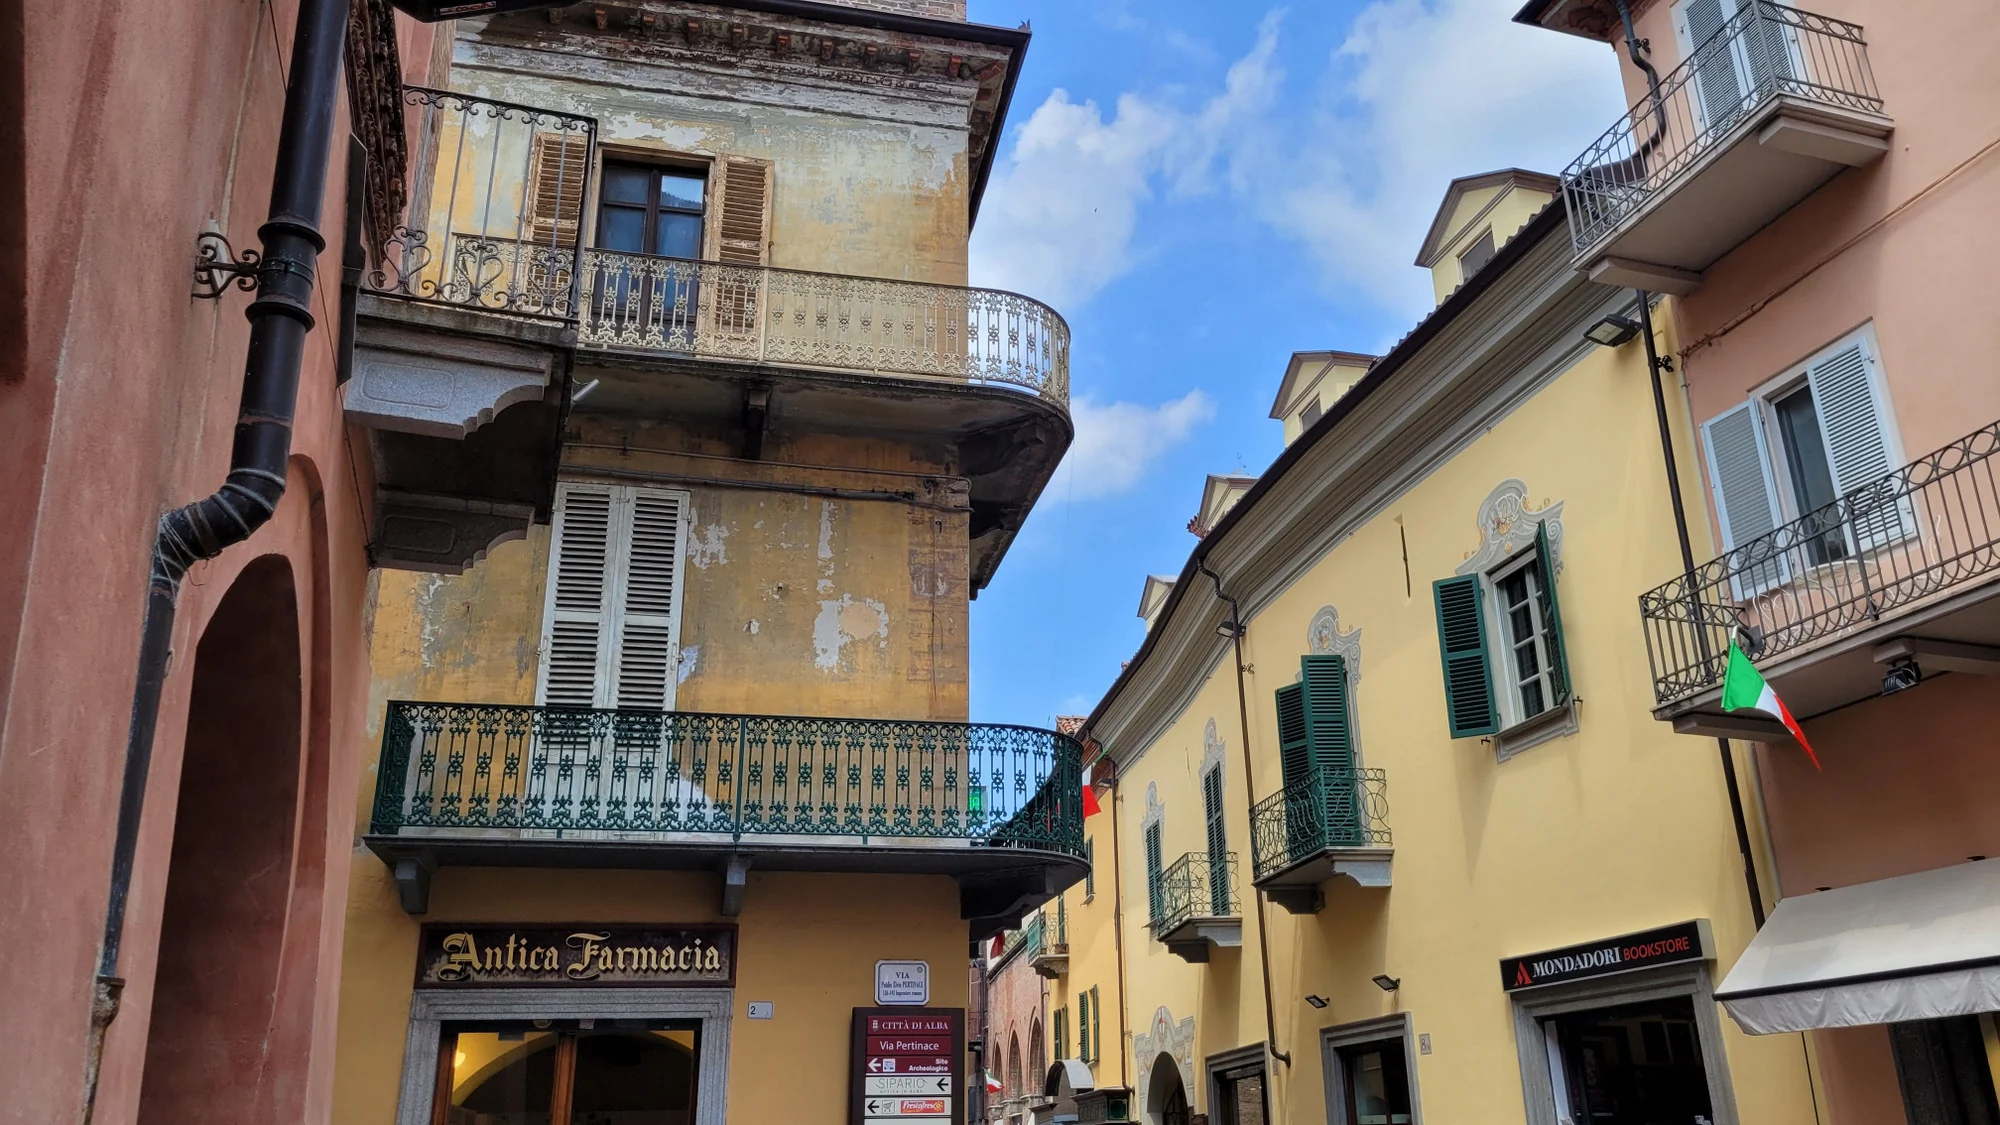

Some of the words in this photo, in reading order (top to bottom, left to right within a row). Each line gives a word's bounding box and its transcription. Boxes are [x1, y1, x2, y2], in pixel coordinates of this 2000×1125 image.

[438, 932, 559, 980] Antica
[565, 931, 721, 979] Farmacia
[1532, 946, 1622, 978] MONDADORI
[1623, 936, 1690, 961] BOOKSTORE
[895, 971, 910, 979] VIA
[750, 1005, 756, 1015] 2
[882, 1019, 909, 1030] CITTÀ
[912, 1022, 922, 1030] DI
[924, 1022, 949, 1030] ALBA
[879, 1040, 894, 1050] Via
[896, 1040, 940, 1051] Pertinace
[908, 1065, 949, 1073] Archeologico
[875, 1077, 928, 1089] SIPARIO
